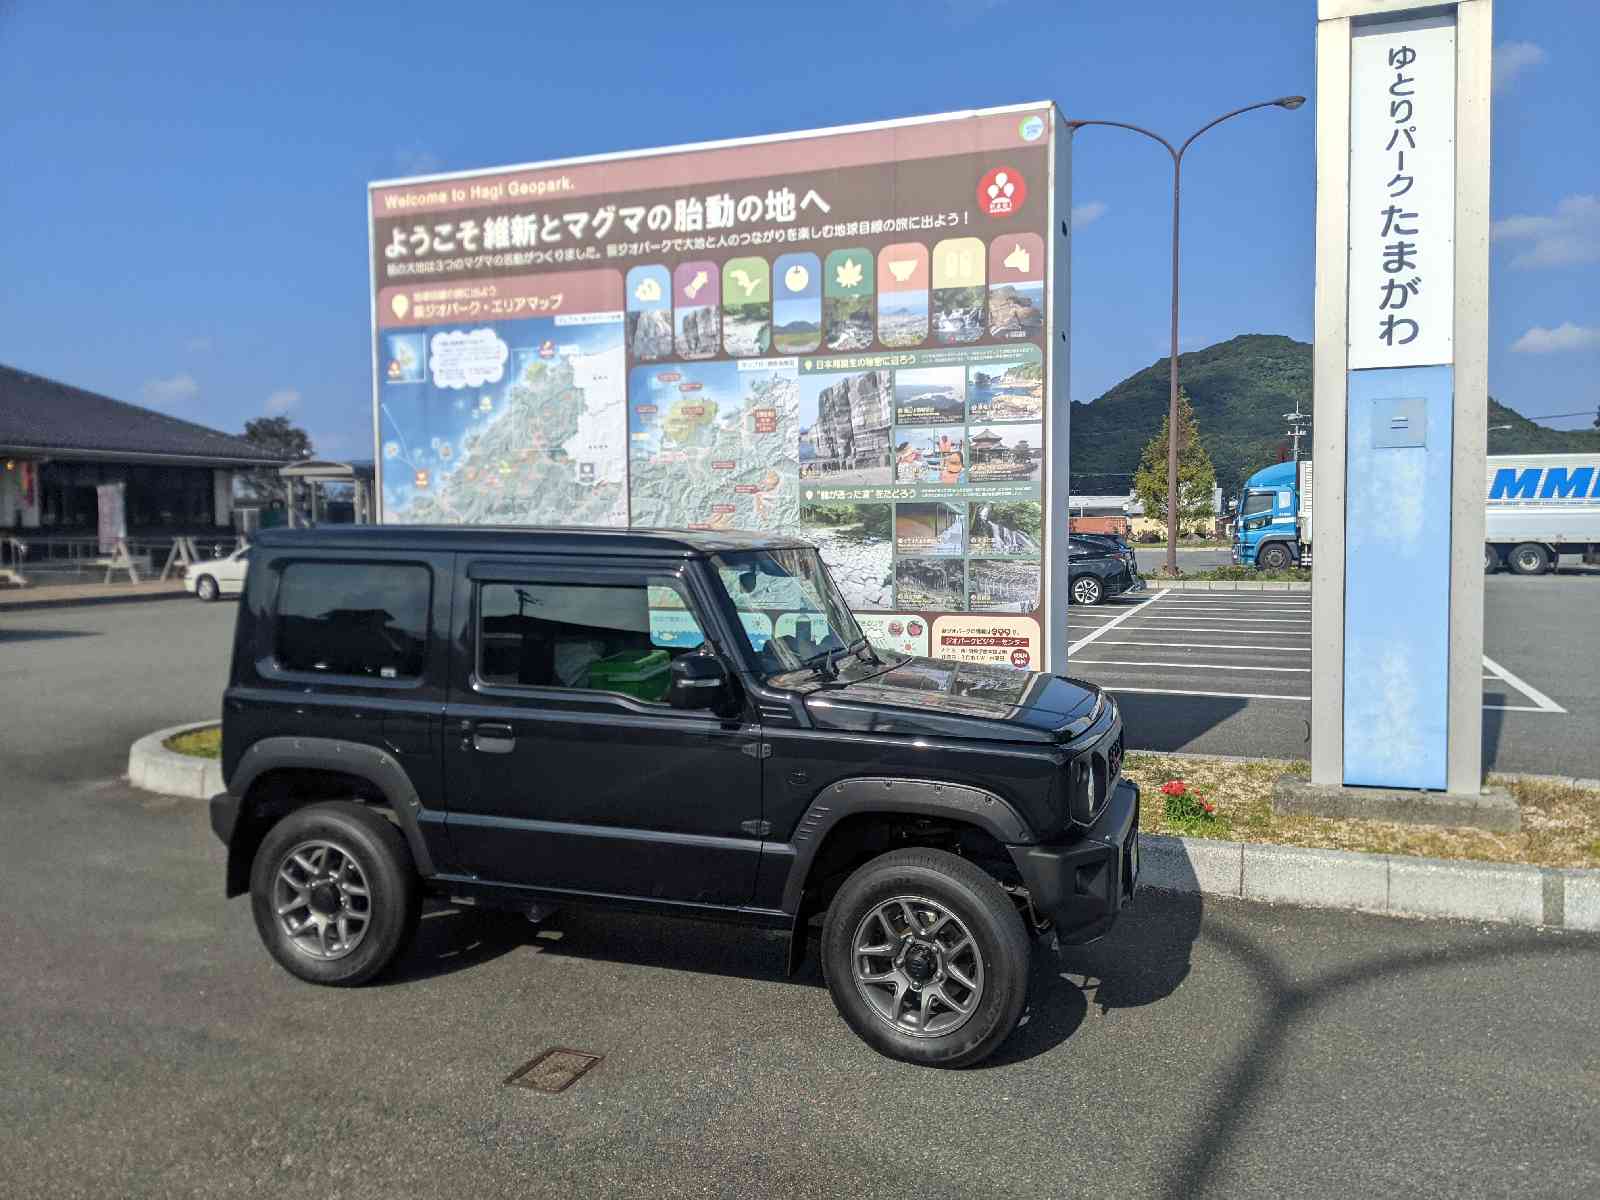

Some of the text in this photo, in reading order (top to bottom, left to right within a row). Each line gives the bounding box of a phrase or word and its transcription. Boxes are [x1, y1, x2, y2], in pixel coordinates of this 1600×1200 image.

[384, 176, 575, 209] Welcome to Hagi Geopark.
[1378, 45, 1421, 348] ゆとりパークたまがわ
[385, 187, 831, 259] ようこそ維新とマグマの胎動の地へ
[1487, 467, 1600, 499] MM
